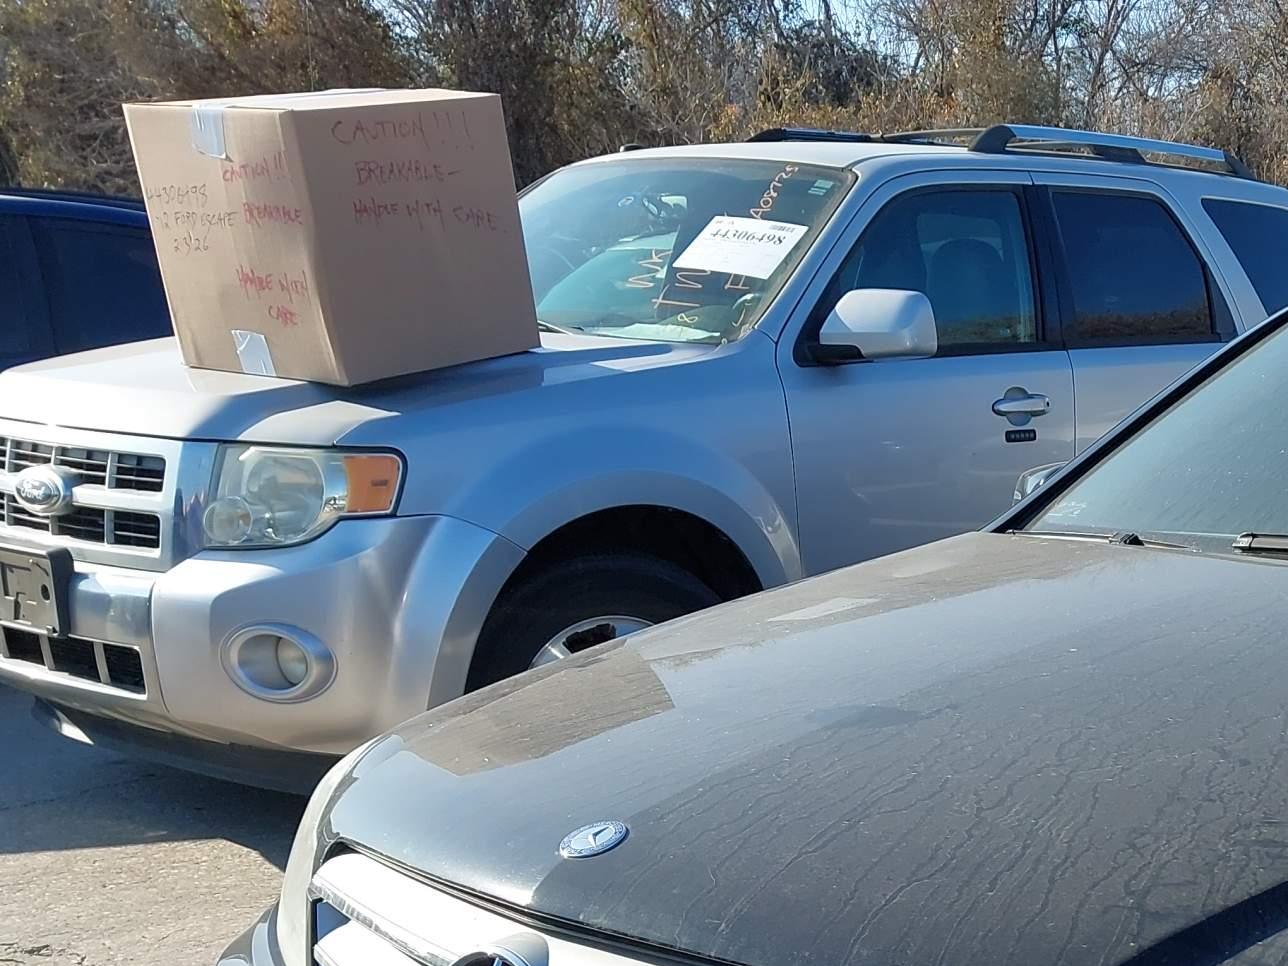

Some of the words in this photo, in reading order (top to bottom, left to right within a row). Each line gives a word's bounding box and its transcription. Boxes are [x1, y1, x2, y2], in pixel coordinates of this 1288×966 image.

[174, 212, 197, 228] FORD
[200, 211, 239, 229] ESCAPE
[711, 228, 786, 245] 44306498
